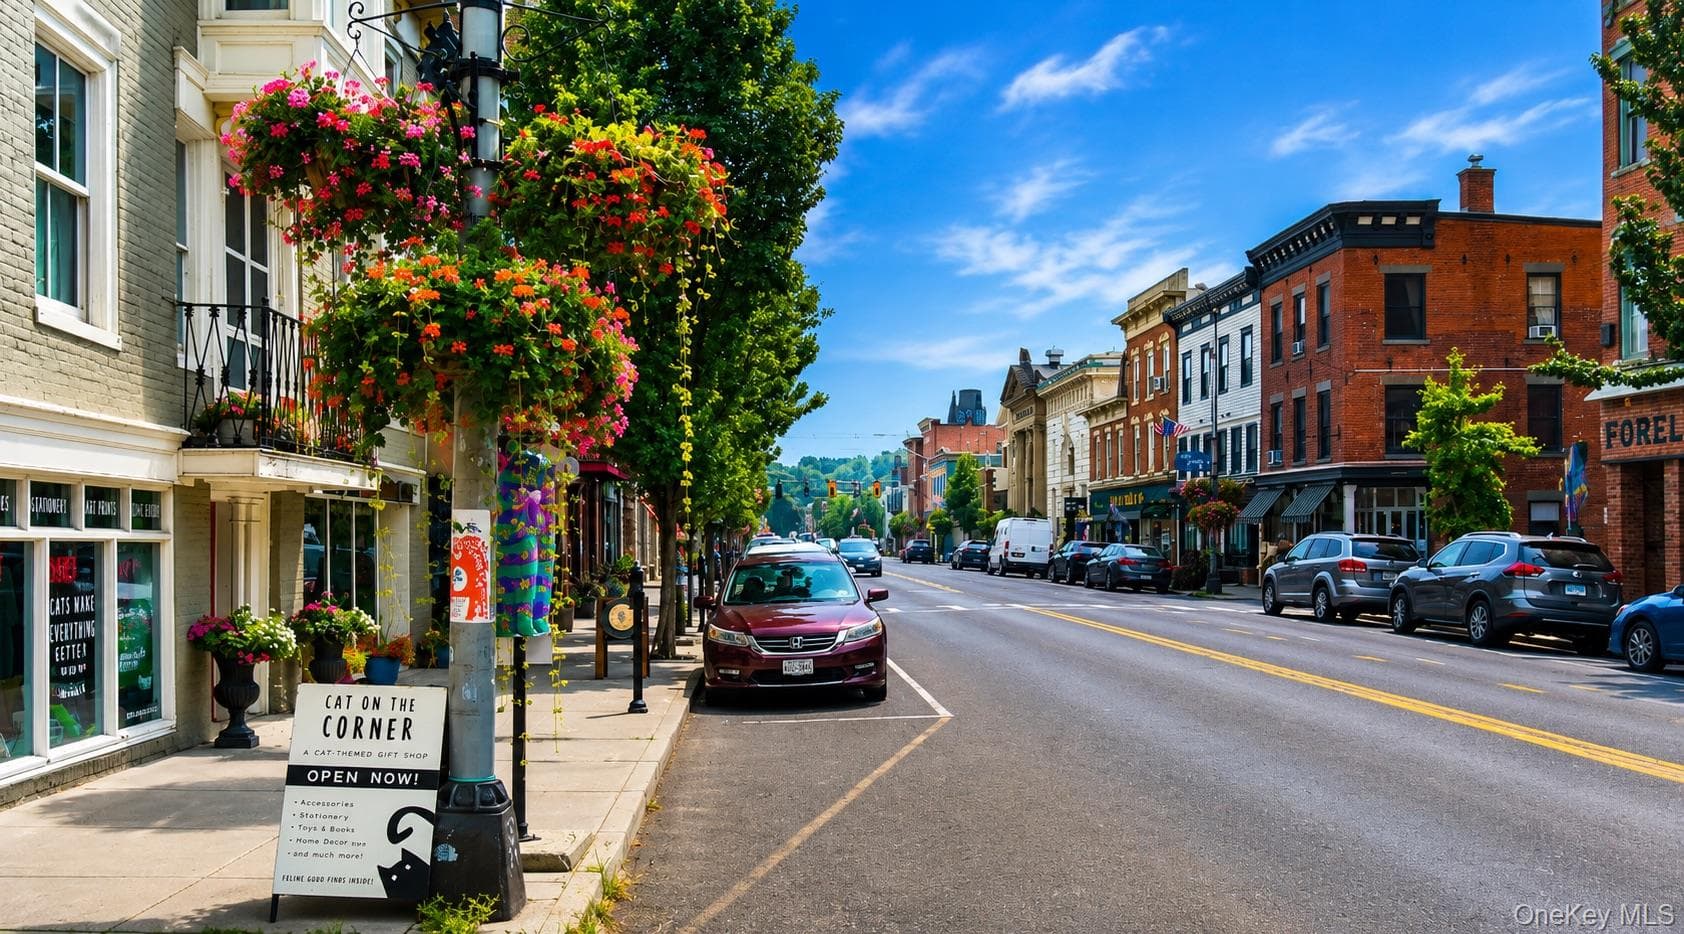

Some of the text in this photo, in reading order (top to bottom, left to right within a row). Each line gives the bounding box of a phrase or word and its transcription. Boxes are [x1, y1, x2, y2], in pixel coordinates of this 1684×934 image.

[50, 597, 70, 616] CATS
[49, 620, 95, 643] EVERYTHING
[325, 695, 415, 712] CAT ON THE
[322, 715, 413, 741] CORNER
[314, 749, 373, 758] CAT-THEMED
[403, 752, 429, 760] SHOP
[307, 769, 419, 786] OPEN NOW!
[301, 800, 354, 808] Accessories
[299, 812, 349, 821] Stationery
[298, 825, 356, 834] Toys & Books
[295, 838, 320, 846] Home
[323, 838, 348, 847] Decor
[312, 851, 335, 859] much
[338, 852, 364, 860] more!
[282, 874, 304, 882] FELINE
[326, 876, 347, 884] FINDS
